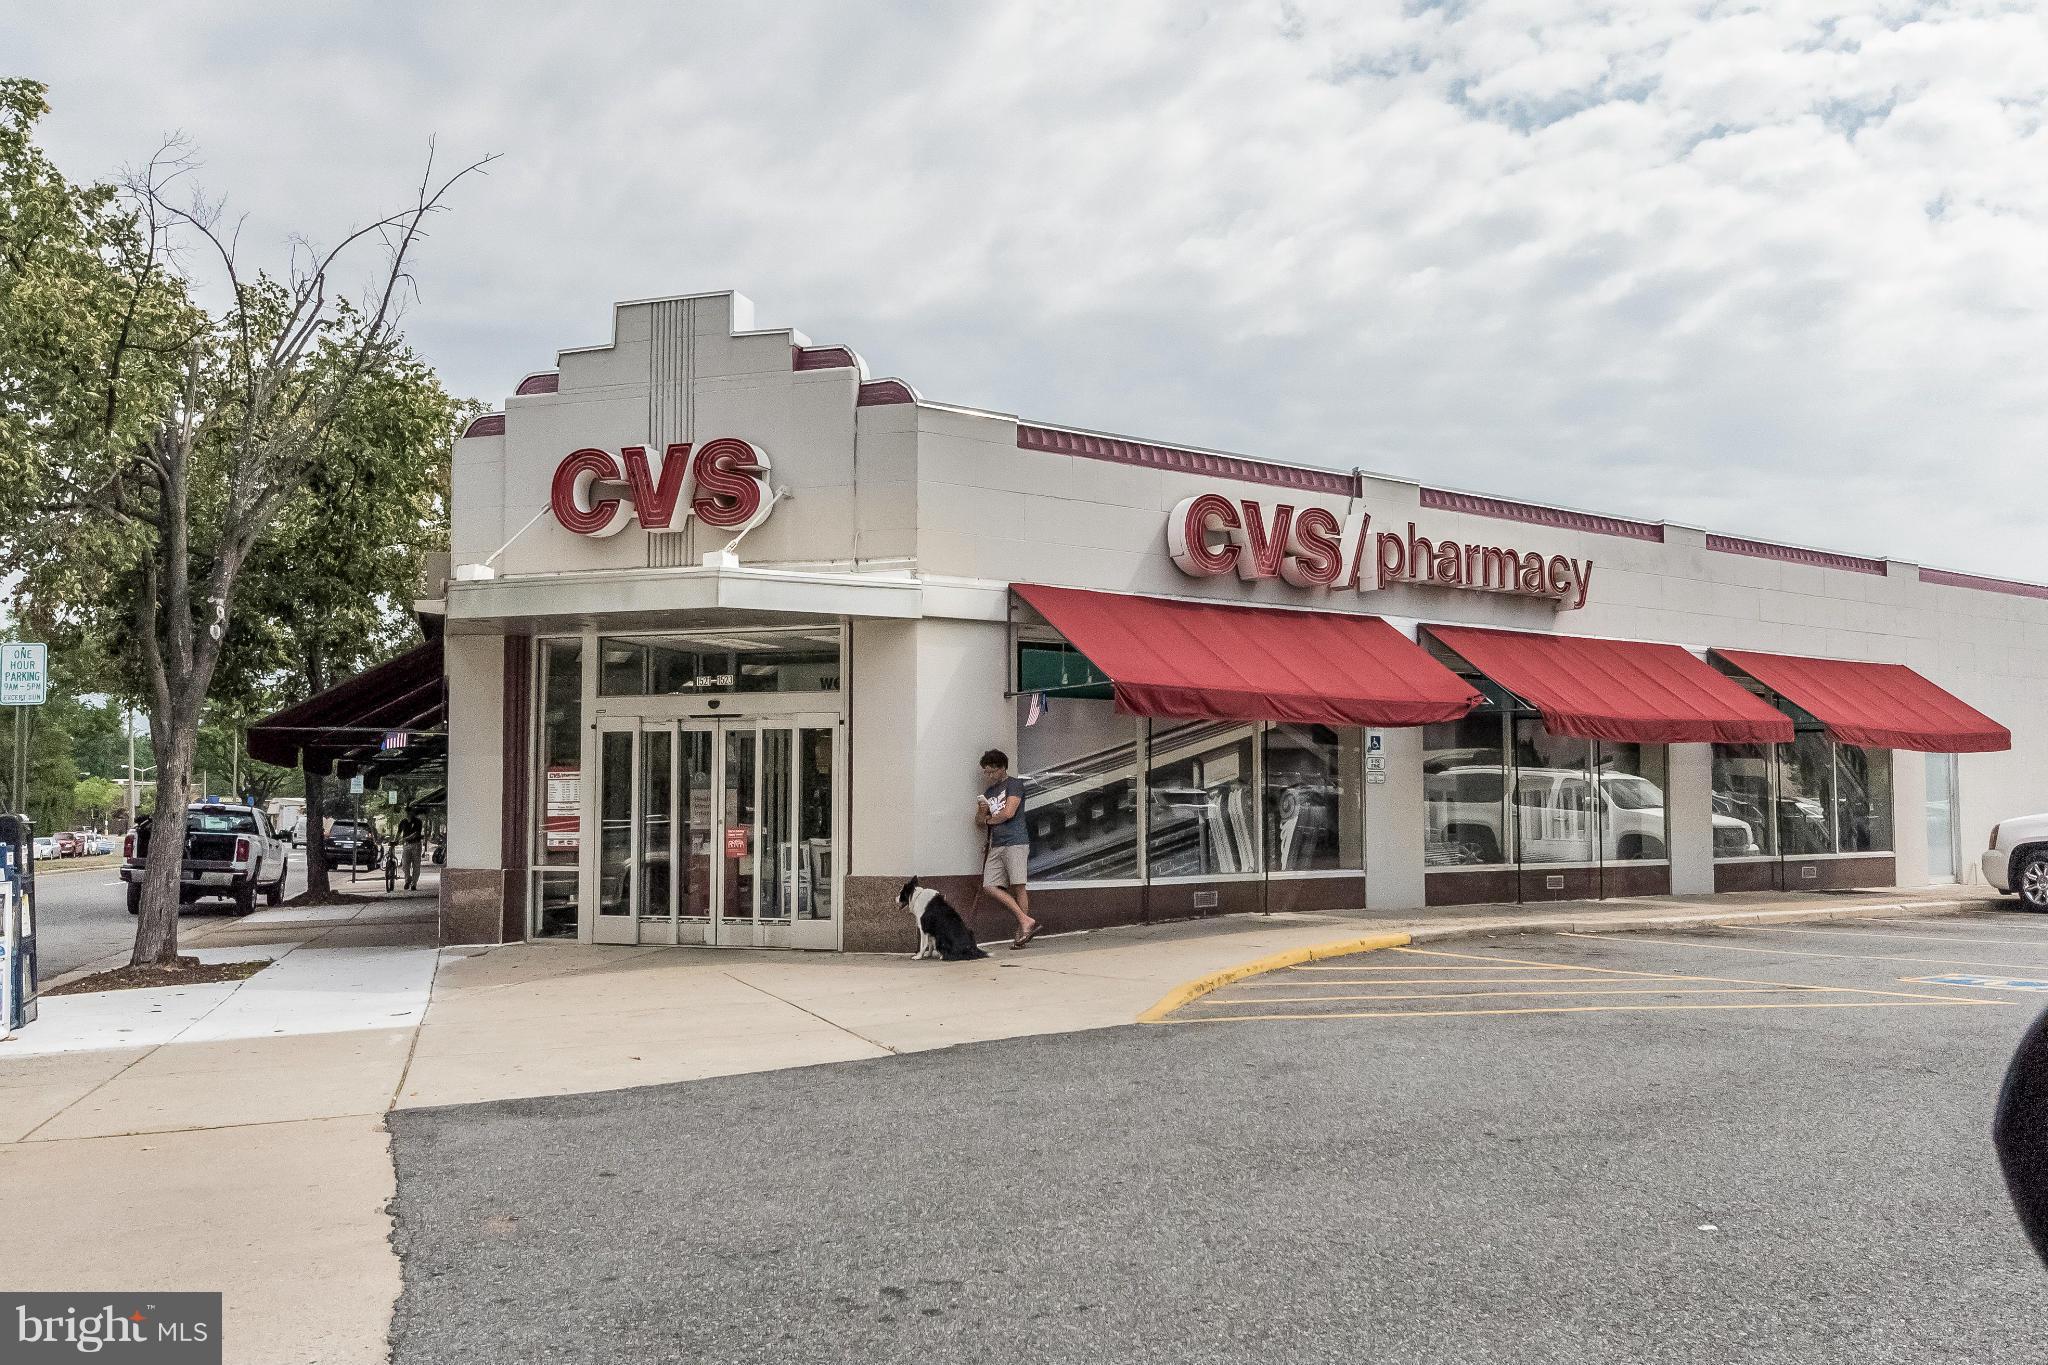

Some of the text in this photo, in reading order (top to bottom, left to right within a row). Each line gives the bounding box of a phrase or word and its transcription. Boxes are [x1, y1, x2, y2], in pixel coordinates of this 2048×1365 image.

[551, 438, 766, 535] CVS
[14, 650, 32, 658] ONE
[11, 661, 35, 669] HOUR
[5, 671, 40, 681] PARKING
